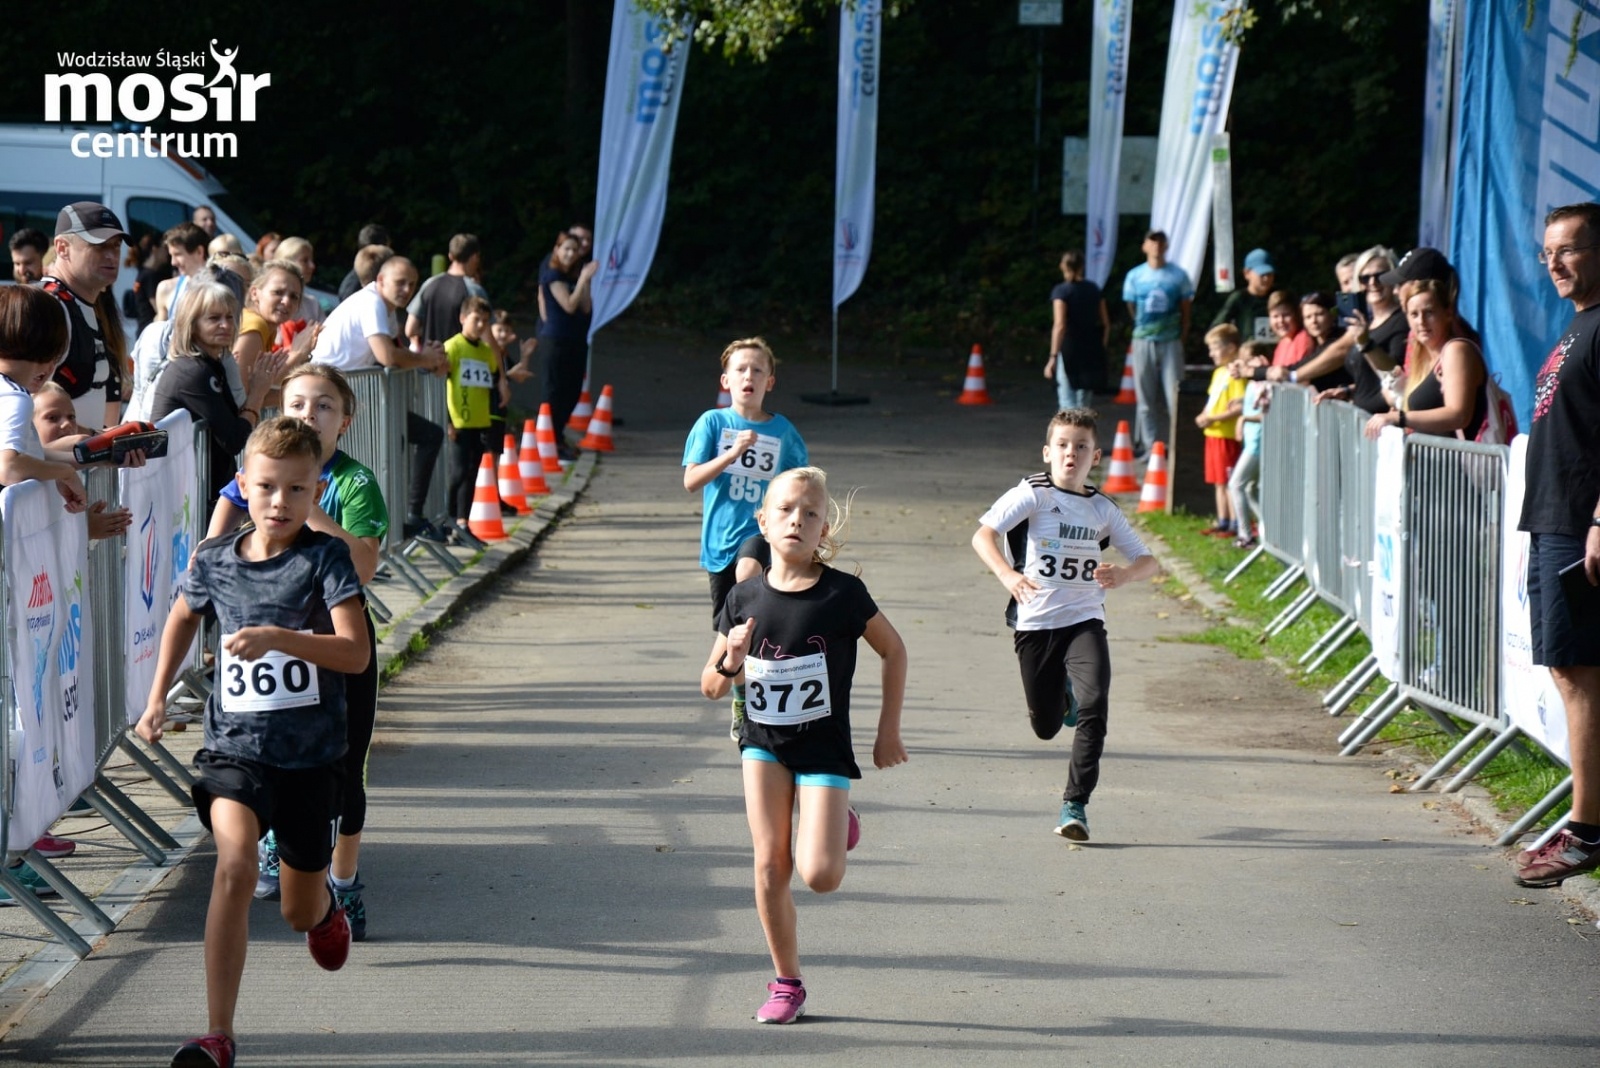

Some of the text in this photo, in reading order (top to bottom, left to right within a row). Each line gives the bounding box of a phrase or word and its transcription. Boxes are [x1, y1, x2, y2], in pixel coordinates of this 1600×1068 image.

[462, 368, 490, 382] 412
[1039, 554, 1098, 582] 358
[226, 659, 311, 697] 360
[749, 679, 825, 713] 372
